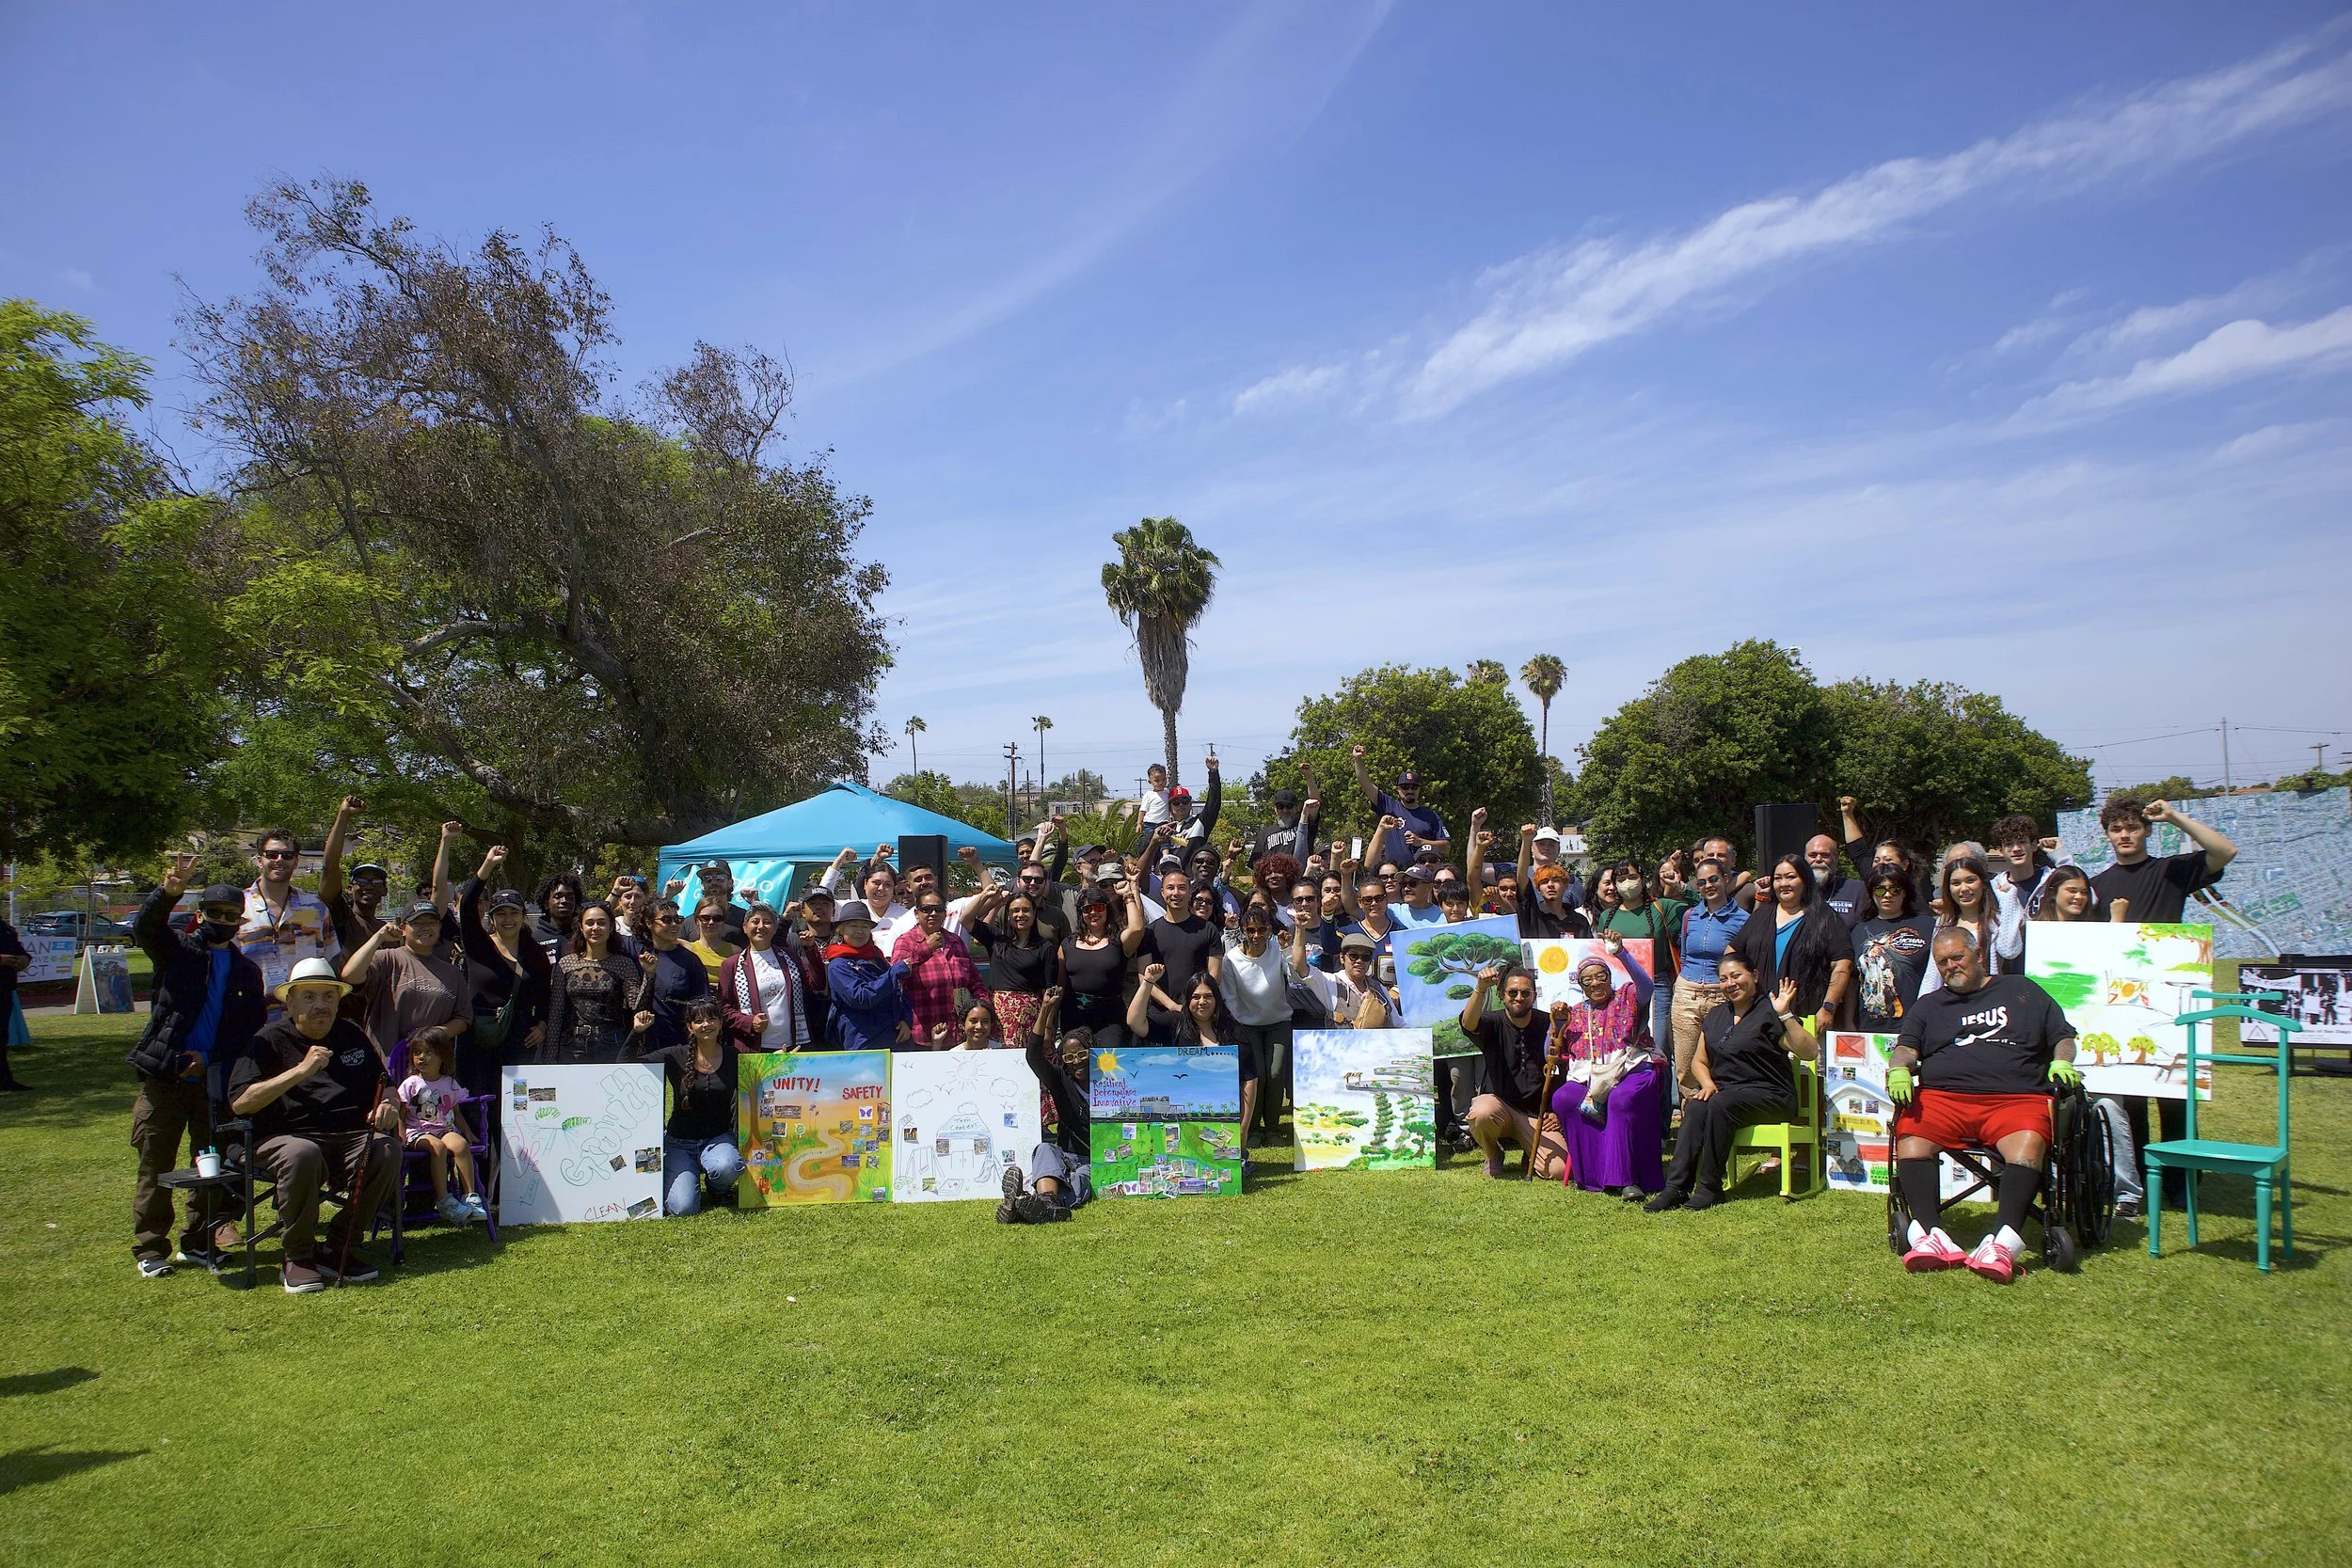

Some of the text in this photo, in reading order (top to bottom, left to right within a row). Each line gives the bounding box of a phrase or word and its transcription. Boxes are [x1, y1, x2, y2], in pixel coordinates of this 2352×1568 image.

[772, 1077, 821, 1093] UNITY!
[842, 1085, 883, 1101] SAFETY
[583, 1196, 628, 1222] CLEAN
